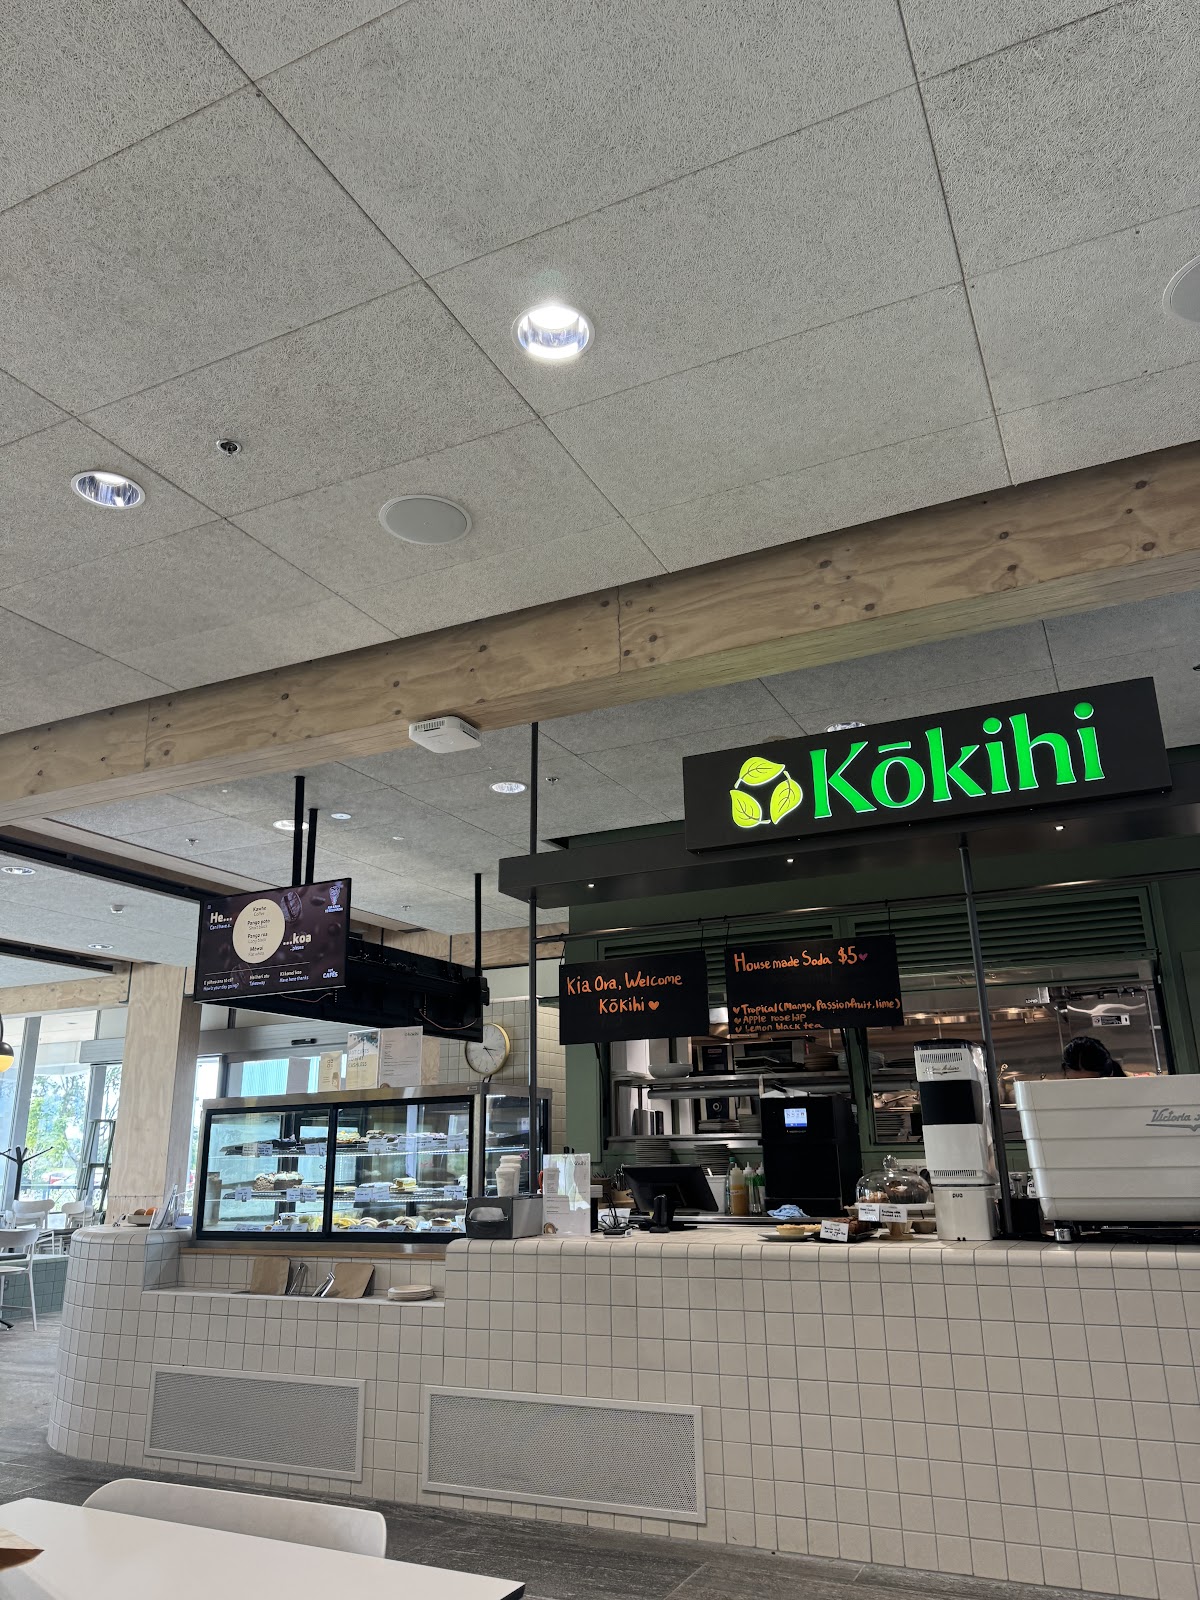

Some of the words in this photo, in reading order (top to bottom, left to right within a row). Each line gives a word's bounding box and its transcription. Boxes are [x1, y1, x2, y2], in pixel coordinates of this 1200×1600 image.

[809, 702, 1106, 819] Kōkihi
[210, 912, 232, 923] He...
[283, 933, 311, 945] ...koa
[802, 950, 833, 966] Soda
[838, 946, 858, 965] $5
[566, 976, 593, 995] Kia
[595, 975, 622, 991] Ora,
[624, 971, 683, 989] Welcome
[743, 1015, 767, 1024] Apple
[776, 1022, 801, 1030] black
[1151, 1108, 1191, 1122] Victoria
